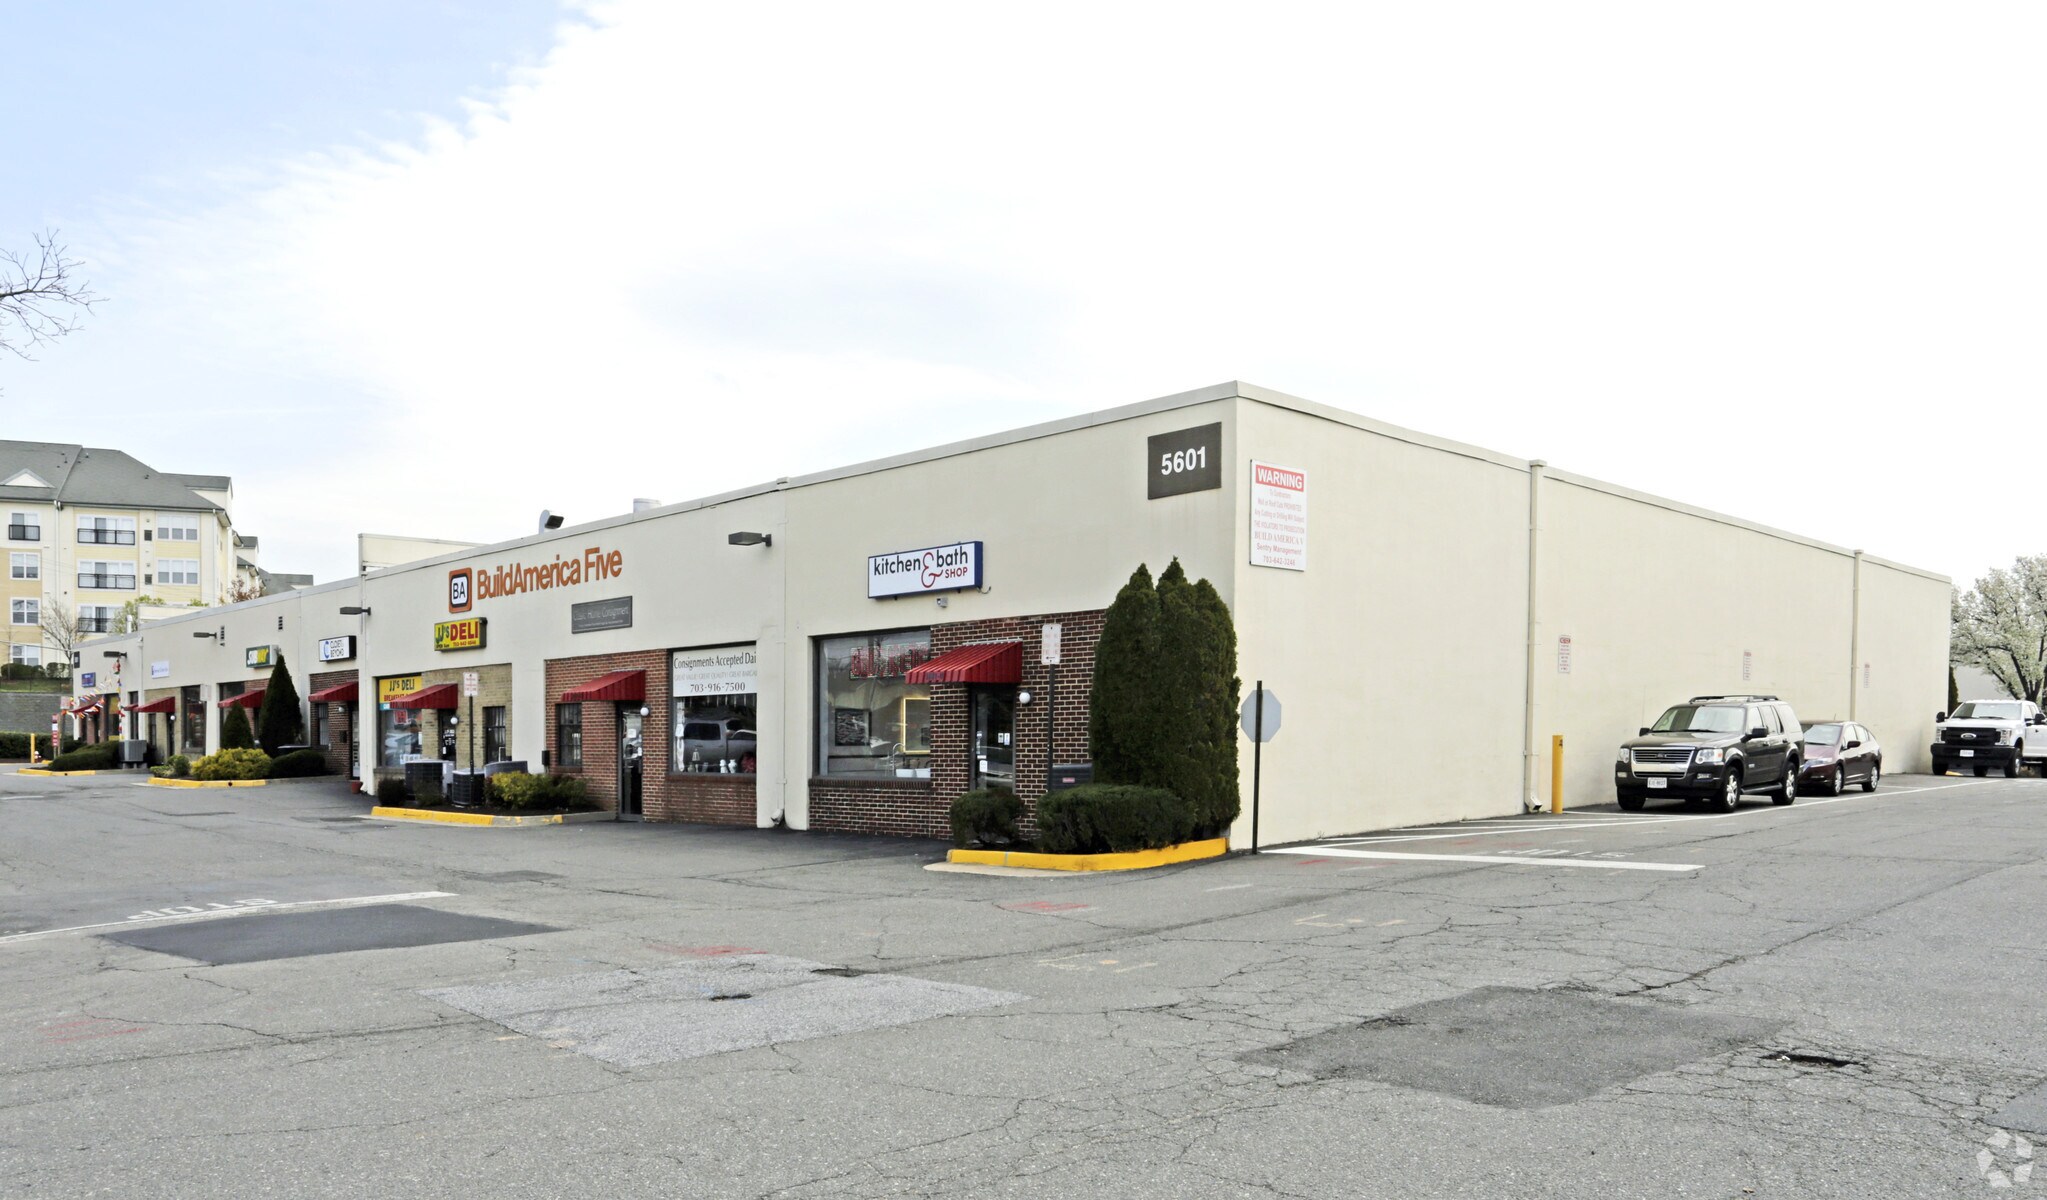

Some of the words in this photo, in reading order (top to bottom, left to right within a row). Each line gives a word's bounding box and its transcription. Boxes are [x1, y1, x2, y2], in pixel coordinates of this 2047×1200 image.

[1161, 446, 1205, 475] 5601
[1257, 467, 1303, 490] WARNING
[1254, 531, 1272, 541] BUILD
[1273, 534, 1299, 545] AMERICA
[1256, 542, 1272, 553] Sentry
[1273, 545, 1302, 556] Management
[874, 555, 921, 575] kitchen
[936, 546, 968, 567] bath
[477, 554, 581, 600] BuildAmerica
[584, 547, 623, 583] Five
[945, 567, 968, 578] SHOP
[453, 581, 466, 600] BA
[450, 621, 479, 641] DELI
[674, 656, 714, 671] Consignments
[715, 652, 744, 668] Accepted
[401, 678, 415, 691] DELI
